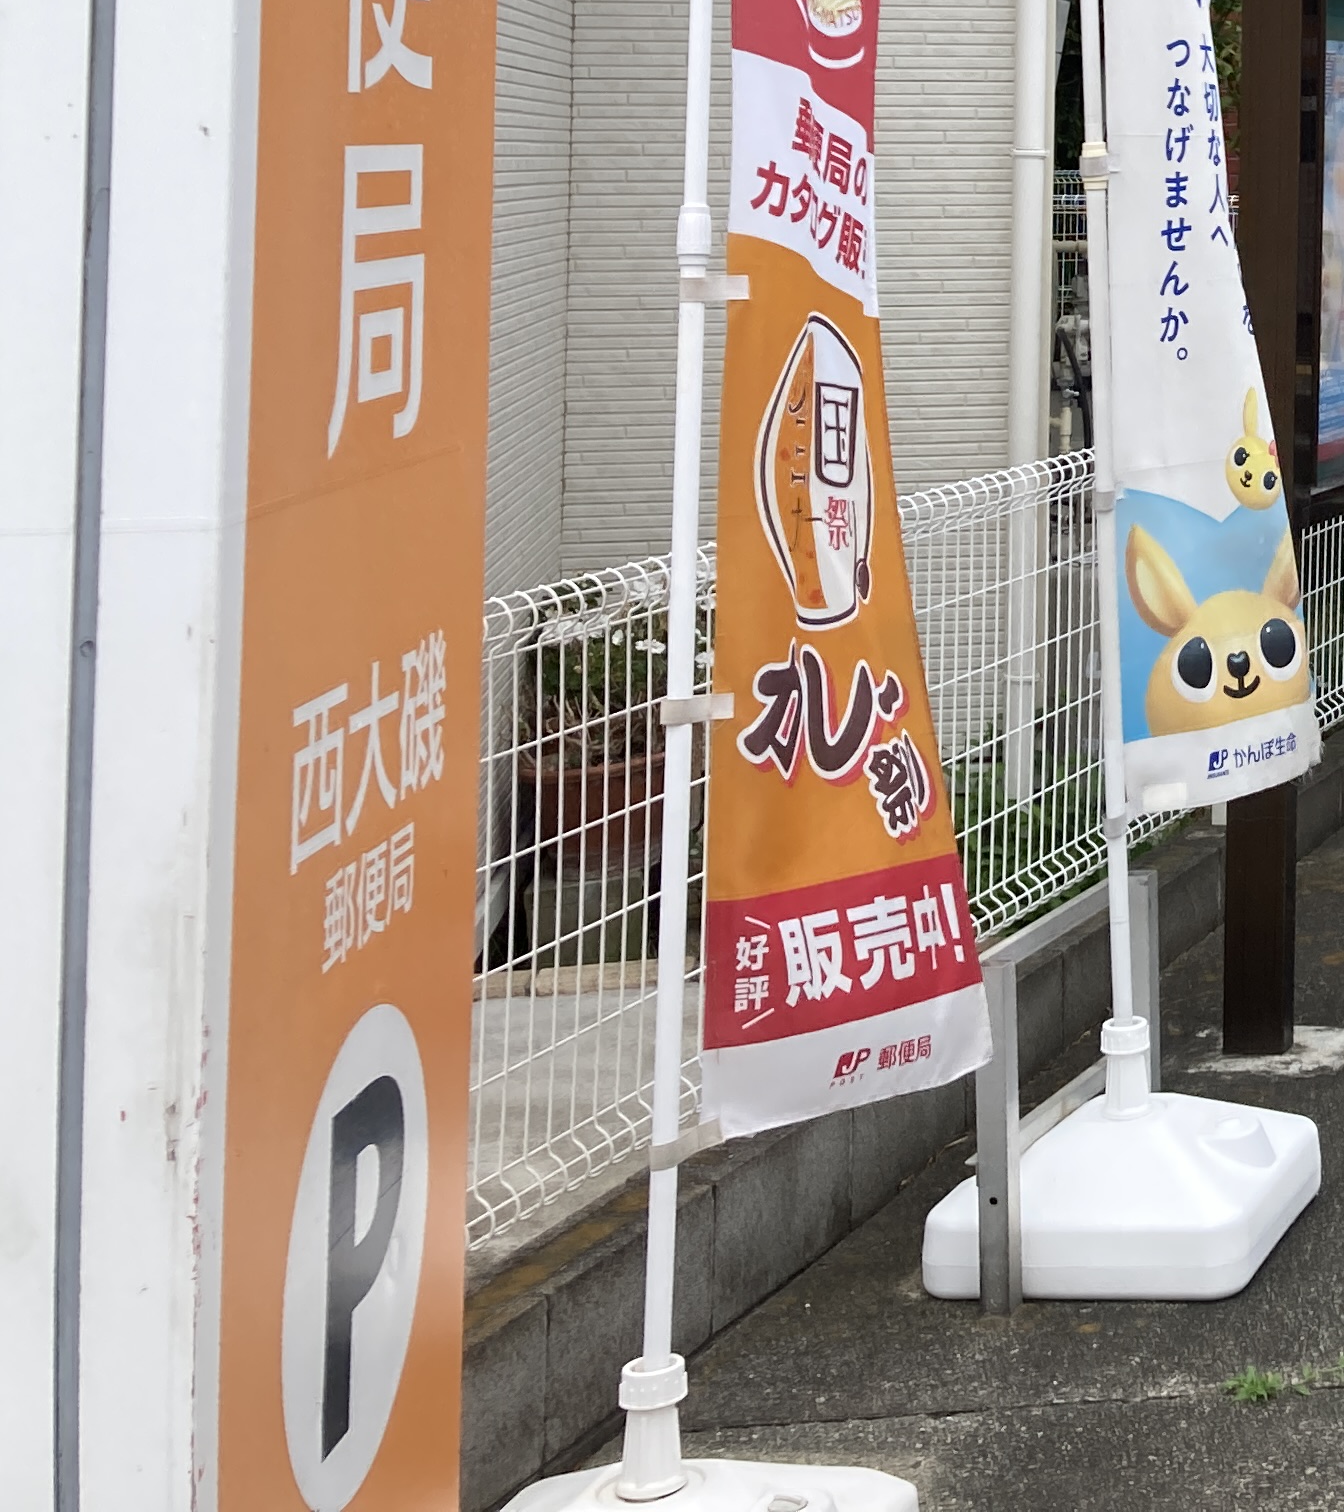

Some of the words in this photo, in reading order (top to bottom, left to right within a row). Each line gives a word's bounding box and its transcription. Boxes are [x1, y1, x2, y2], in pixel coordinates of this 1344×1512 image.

[1160, 38, 1194, 361] つなげませんか。
[289, 628, 447, 875] 西大磯
[1232, 731, 1297, 769] かんぽ生命
[321, 822, 417, 976] 郵便局
[734, 934, 770, 1013] 好評
[876, 1034, 932, 1071] 郵便局
[321, 1074, 406, 1464] P
